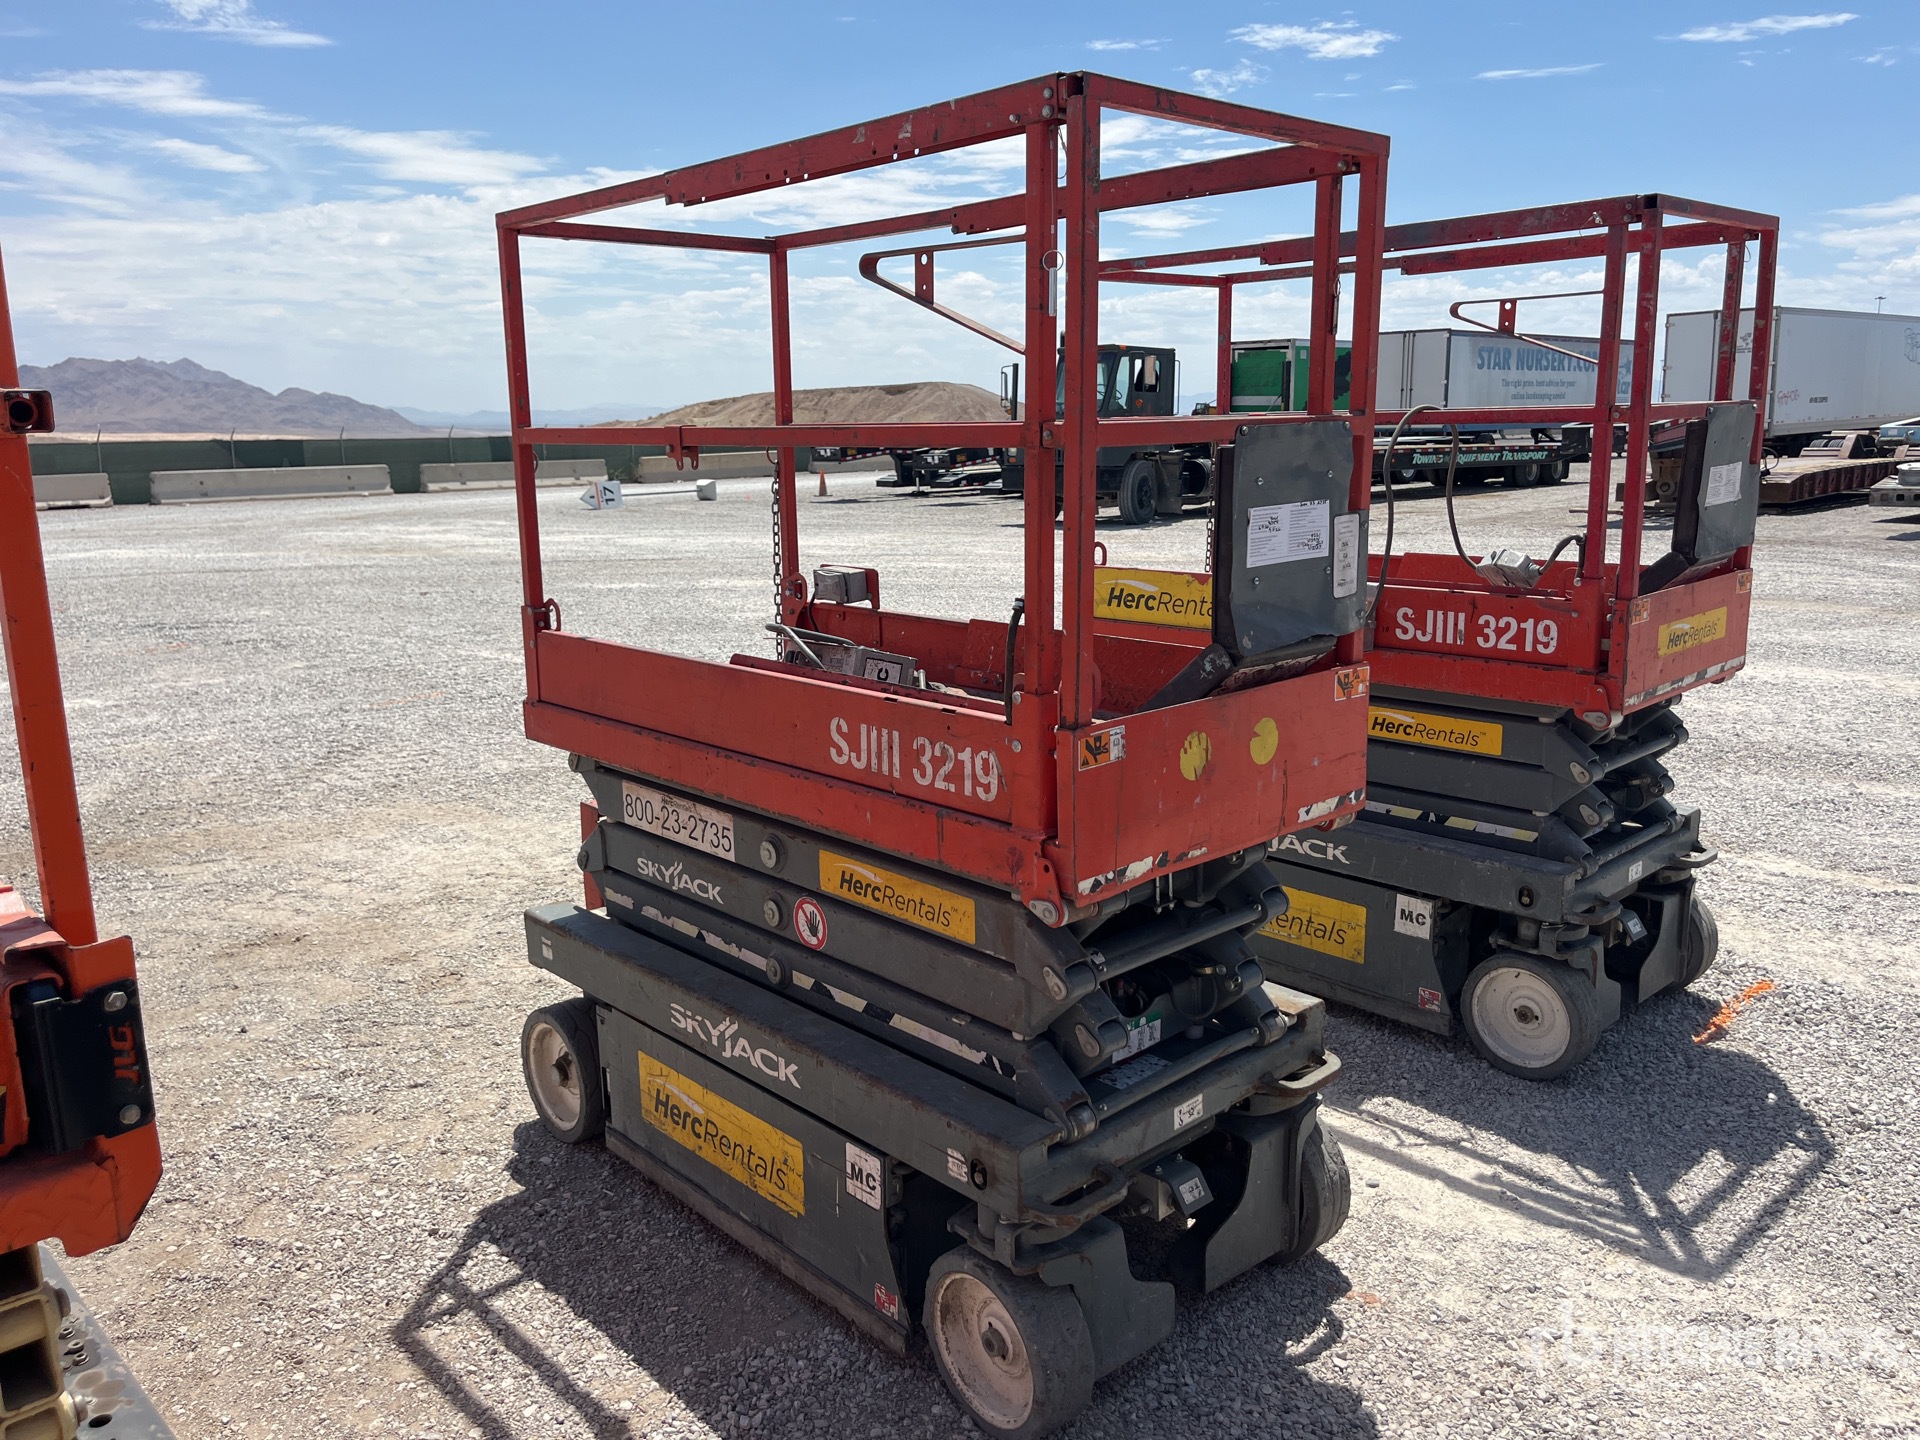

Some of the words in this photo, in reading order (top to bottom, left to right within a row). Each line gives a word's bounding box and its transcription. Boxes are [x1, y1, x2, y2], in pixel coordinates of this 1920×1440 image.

[1477, 346, 1512, 370] STAR
[1456, 452, 1500, 464] QUIPMENT
[1502, 450, 1548, 461] TRANSPORT
[1395, 607, 1466, 645] SJIII
[1477, 615, 1558, 654] 3219
[1667, 620, 1717, 649] HercRentals
[1371, 717, 1480, 747] HercRentals
[829, 717, 900, 779] SJIII
[912, 736, 998, 802] 3219
[625, 793, 732, 853] 800-23-2735
[637, 857, 724, 904] SKYJACK
[839, 870, 951, 928] HercRentals
[1270, 911, 1347, 945] entals
[1400, 908, 1427, 926] MC
[669, 1002, 801, 1089] SKYJACK
[654, 1088, 787, 1192] HercRentals
[850, 1163, 878, 1192] MC
